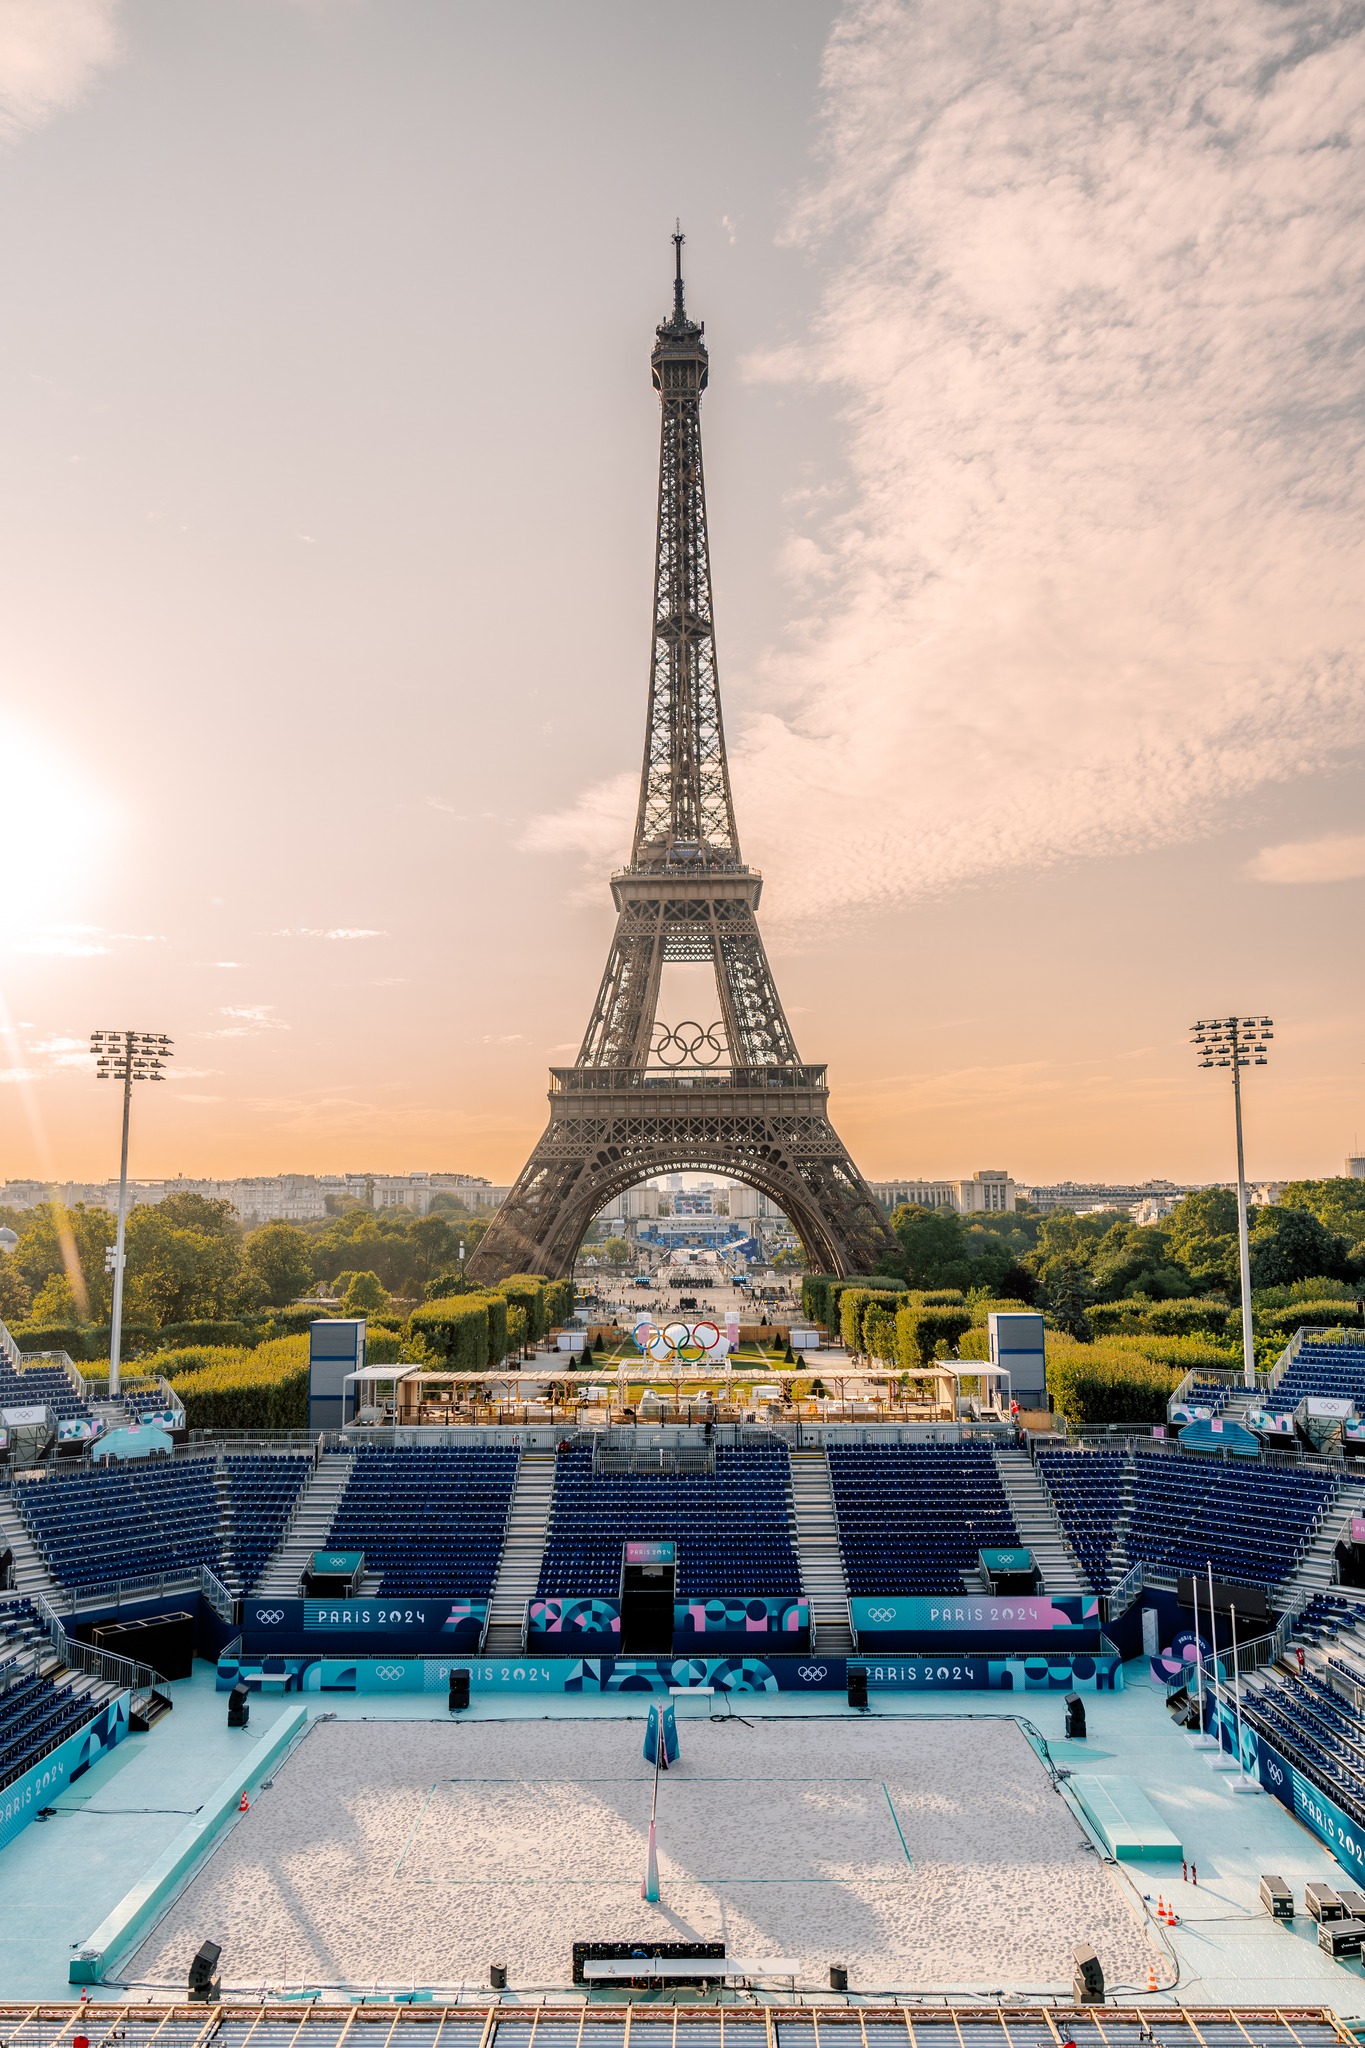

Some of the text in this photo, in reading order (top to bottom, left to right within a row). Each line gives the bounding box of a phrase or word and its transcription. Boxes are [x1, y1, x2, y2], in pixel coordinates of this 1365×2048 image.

[378, 1610, 425, 1623] 2024
[990, 1607, 1038, 1620] 2024
[501, 1667, 550, 1681] 2024
[924, 1666, 974, 1680] 2024
[36, 1761, 64, 1796] 2024
